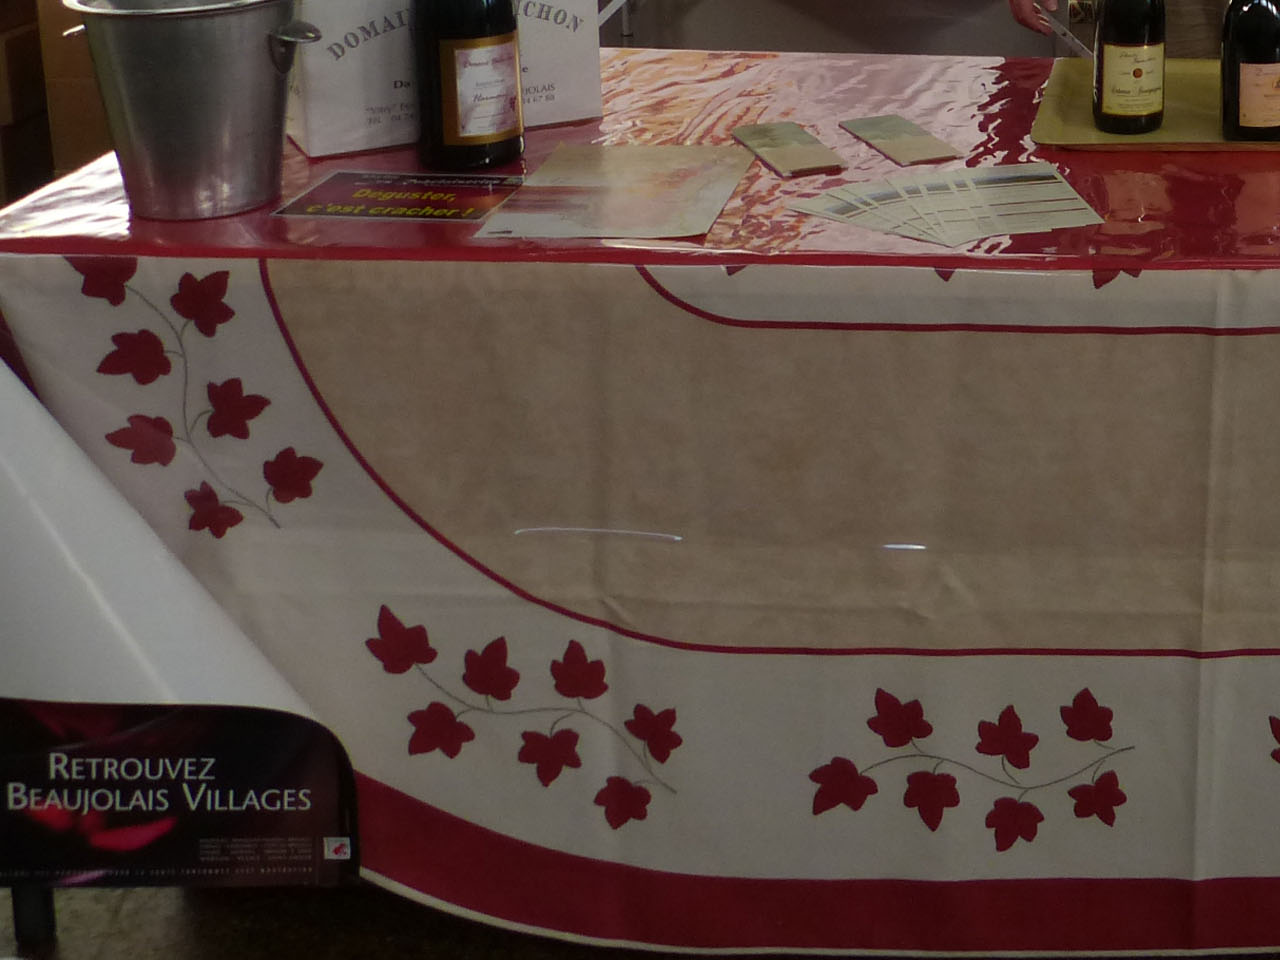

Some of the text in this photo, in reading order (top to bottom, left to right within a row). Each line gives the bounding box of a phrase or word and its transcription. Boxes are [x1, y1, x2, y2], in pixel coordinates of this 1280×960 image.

[49, 752, 216, 781] RETROUVEZ
[6, 781, 312, 815] BEAUJOLAIS VILLAGES
